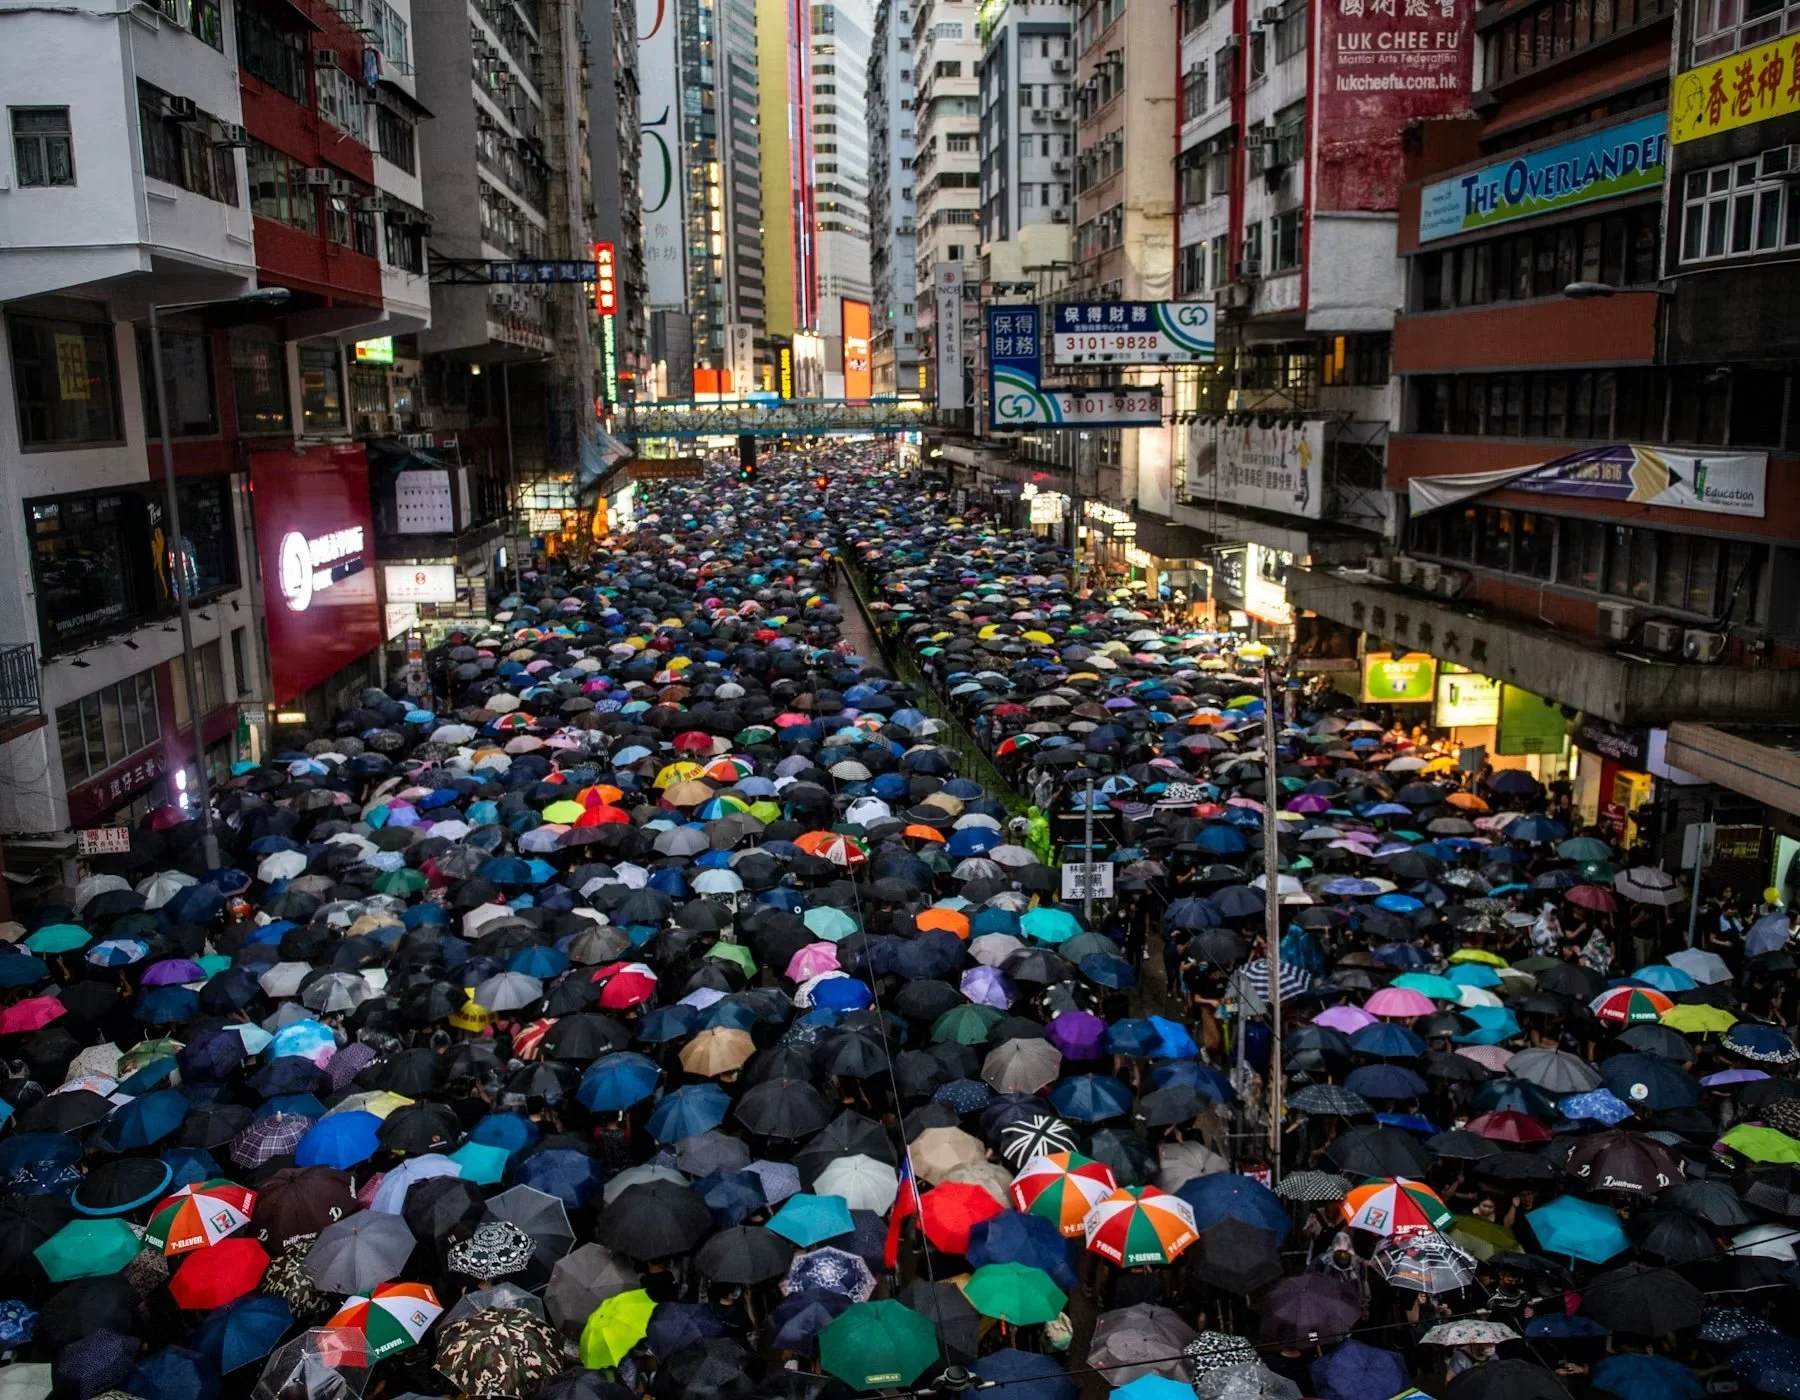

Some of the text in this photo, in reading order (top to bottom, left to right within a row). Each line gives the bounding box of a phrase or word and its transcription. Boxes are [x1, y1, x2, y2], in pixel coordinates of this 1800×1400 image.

[1338, 32, 1458, 50] LUK CHEE FU
[1338, 53, 1456, 64] Martial Arts Federation
[1337, 72, 1457, 90] lukcheefu.com.hk
[1064, 306, 1147, 323] 保得財務
[994, 315, 1033, 335] 保得
[995, 336, 1034, 356] 財務
[1066, 336, 1158, 350] 3101-9828
[1063, 398, 1158, 414] 3101-9828
[1705, 487, 1754, 501] Education
[171, 1236, 204, 1250] 7-ELEVEN
[375, 1338, 404, 1355] 7-ELEVEN
